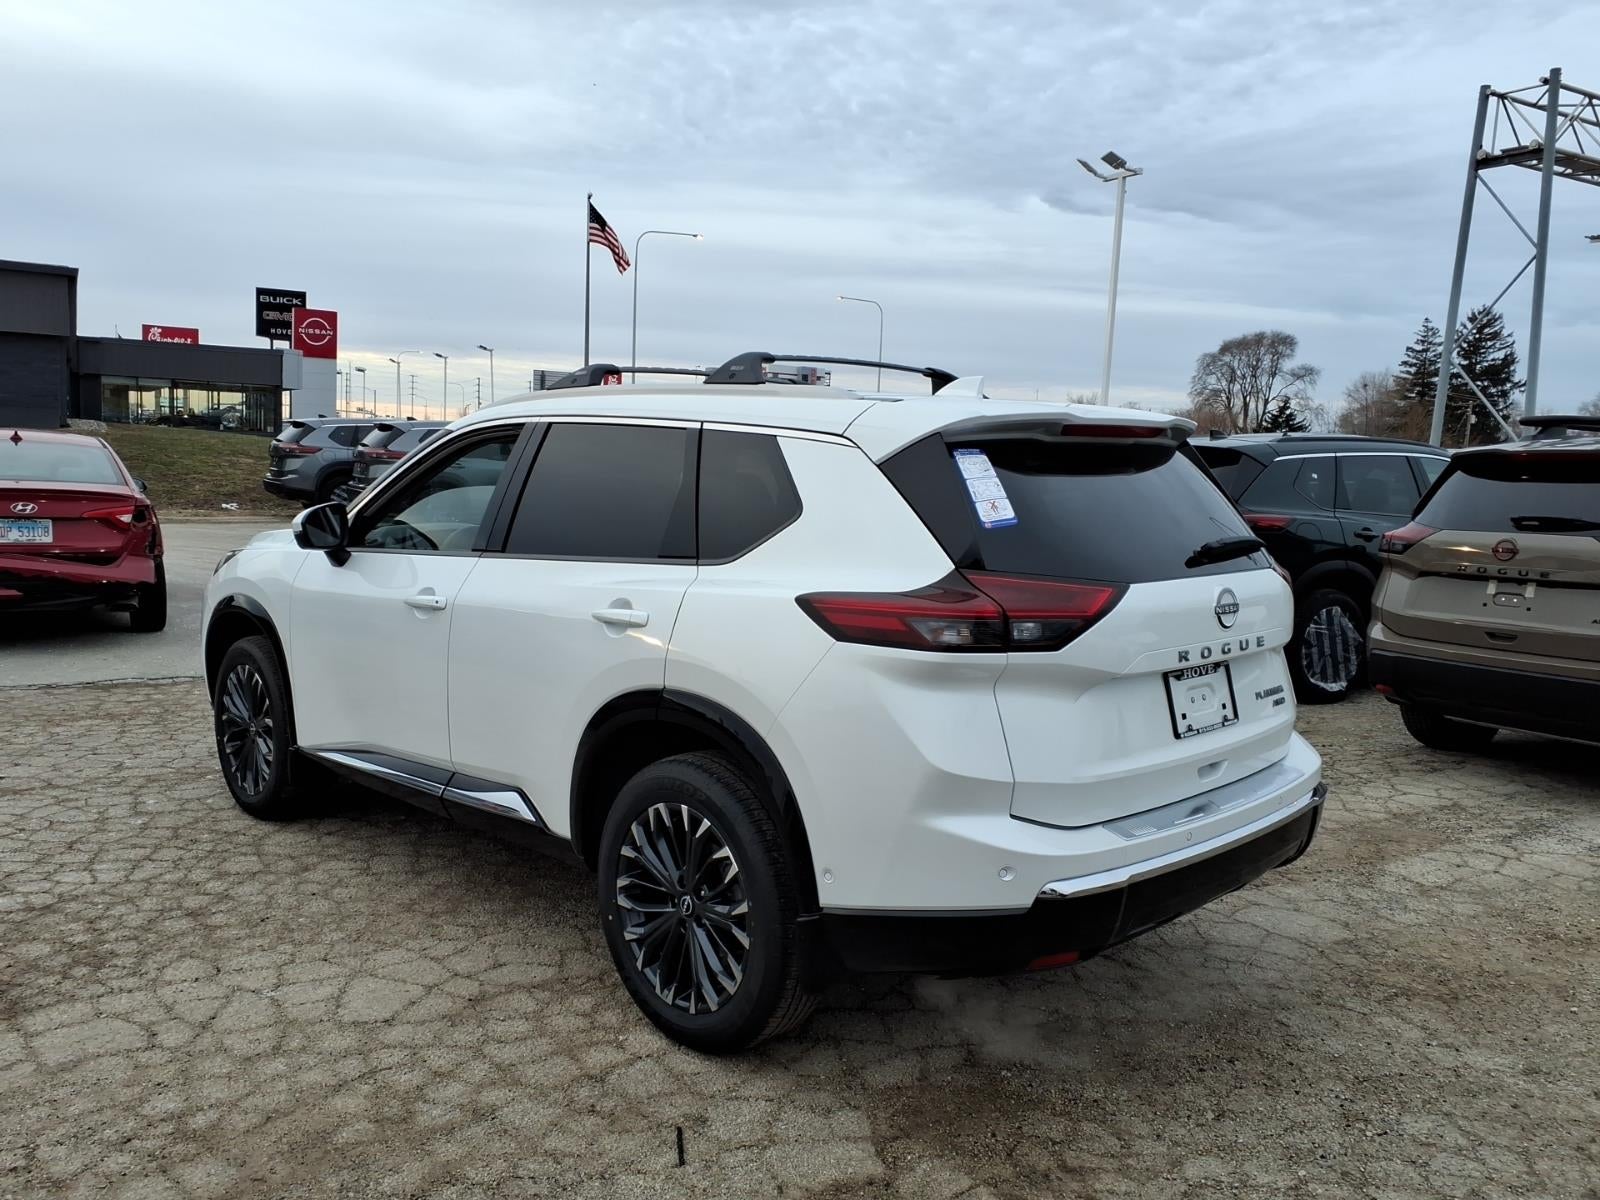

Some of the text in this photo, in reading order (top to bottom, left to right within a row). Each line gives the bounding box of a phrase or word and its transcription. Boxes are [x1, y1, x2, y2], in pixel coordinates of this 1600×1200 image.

[259, 295, 303, 306] BUICK
[298, 327, 334, 336] NISSAN
[18, 526, 49, 538] 53108
[1178, 635, 1266, 664] ROGUE
[1182, 663, 1216, 680] HOVE
